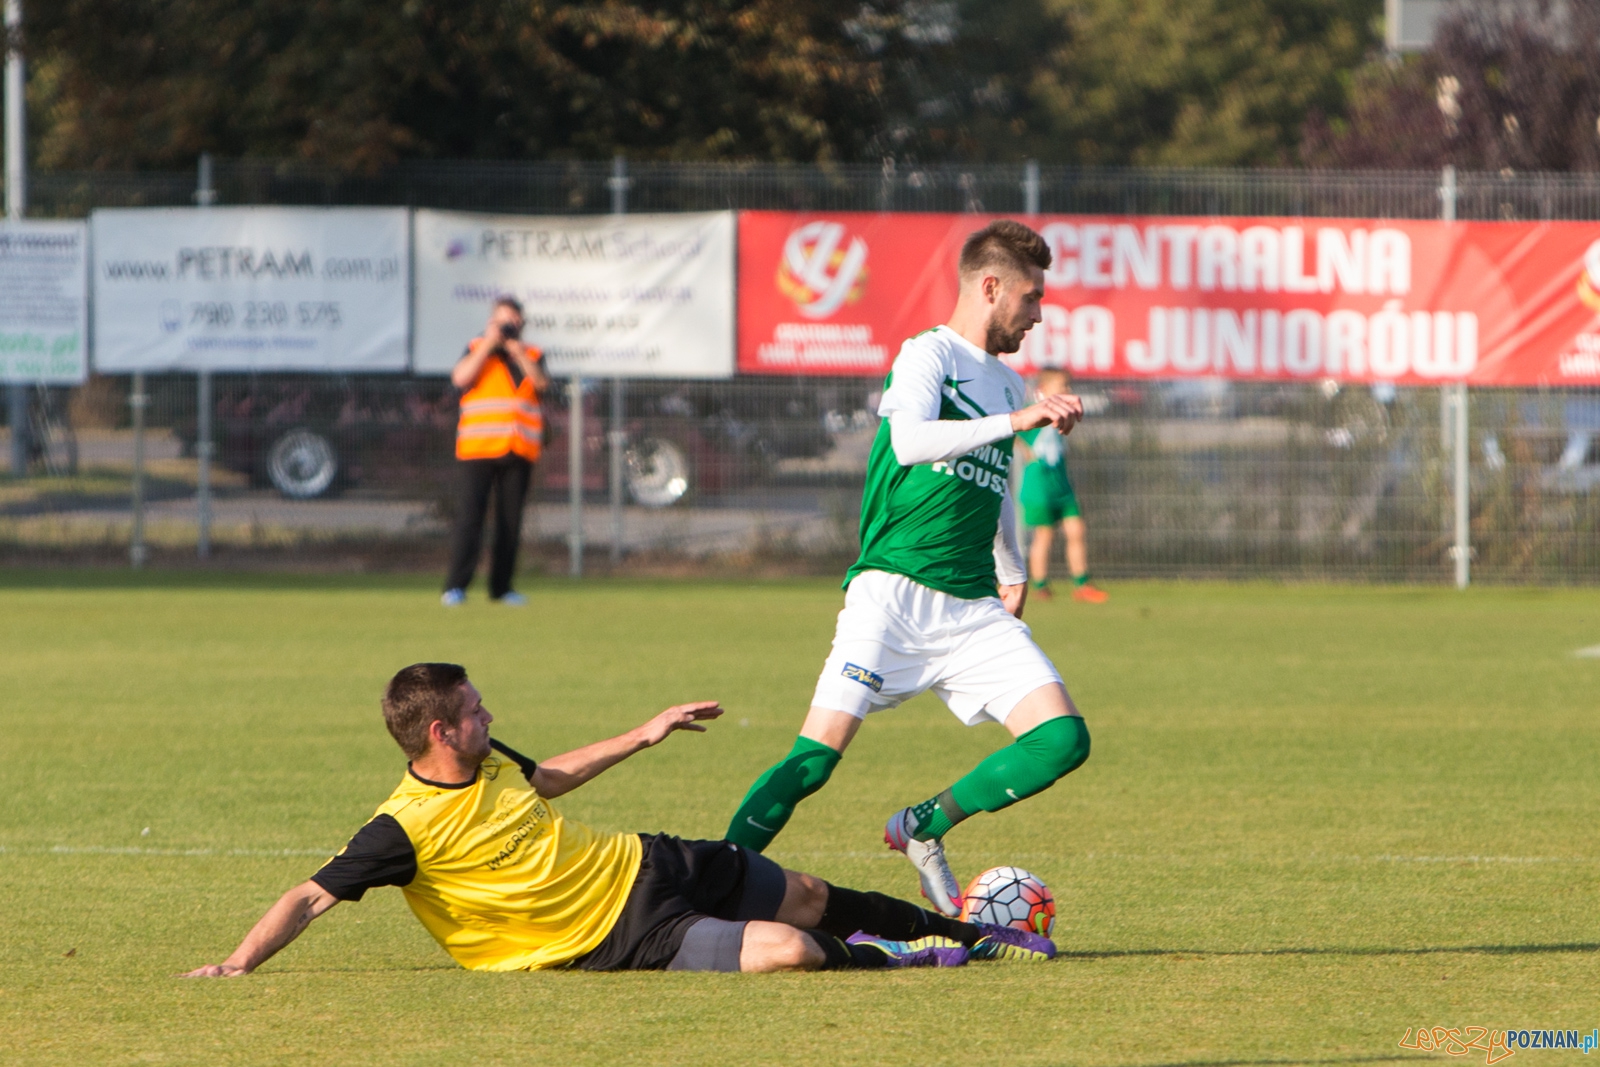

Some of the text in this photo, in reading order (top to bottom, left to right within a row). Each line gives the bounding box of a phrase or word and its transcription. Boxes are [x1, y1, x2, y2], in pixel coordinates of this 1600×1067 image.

[479, 229, 607, 258] PETRAM
[1041, 221, 1412, 294] CENTRALNA
[999, 300, 1478, 377] GA JUNIORÓW
